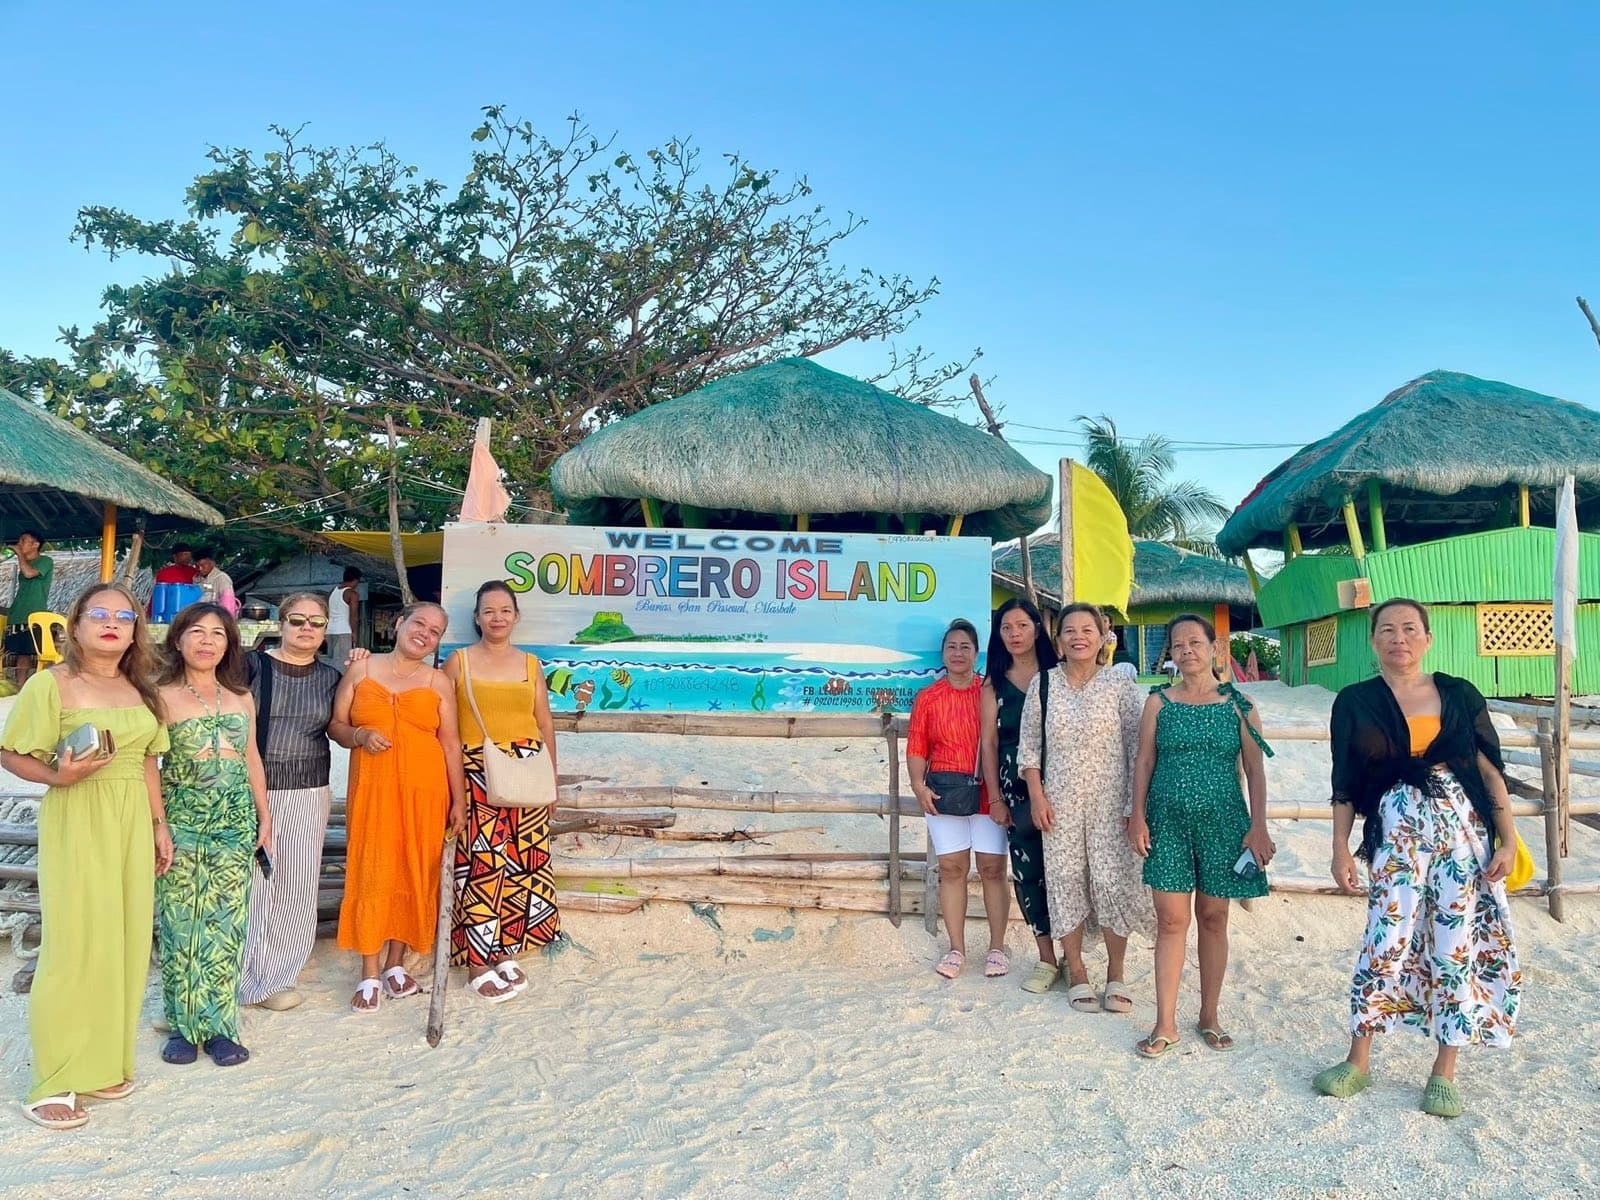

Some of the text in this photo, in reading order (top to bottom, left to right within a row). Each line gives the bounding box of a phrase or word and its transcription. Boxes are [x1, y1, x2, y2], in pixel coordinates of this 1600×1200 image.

[606, 531, 843, 554] WELCOME
[504, 551, 937, 602] SOMBRERO ISLAND
[678, 600, 701, 613] San
[754, 602, 797, 615] Masbate
